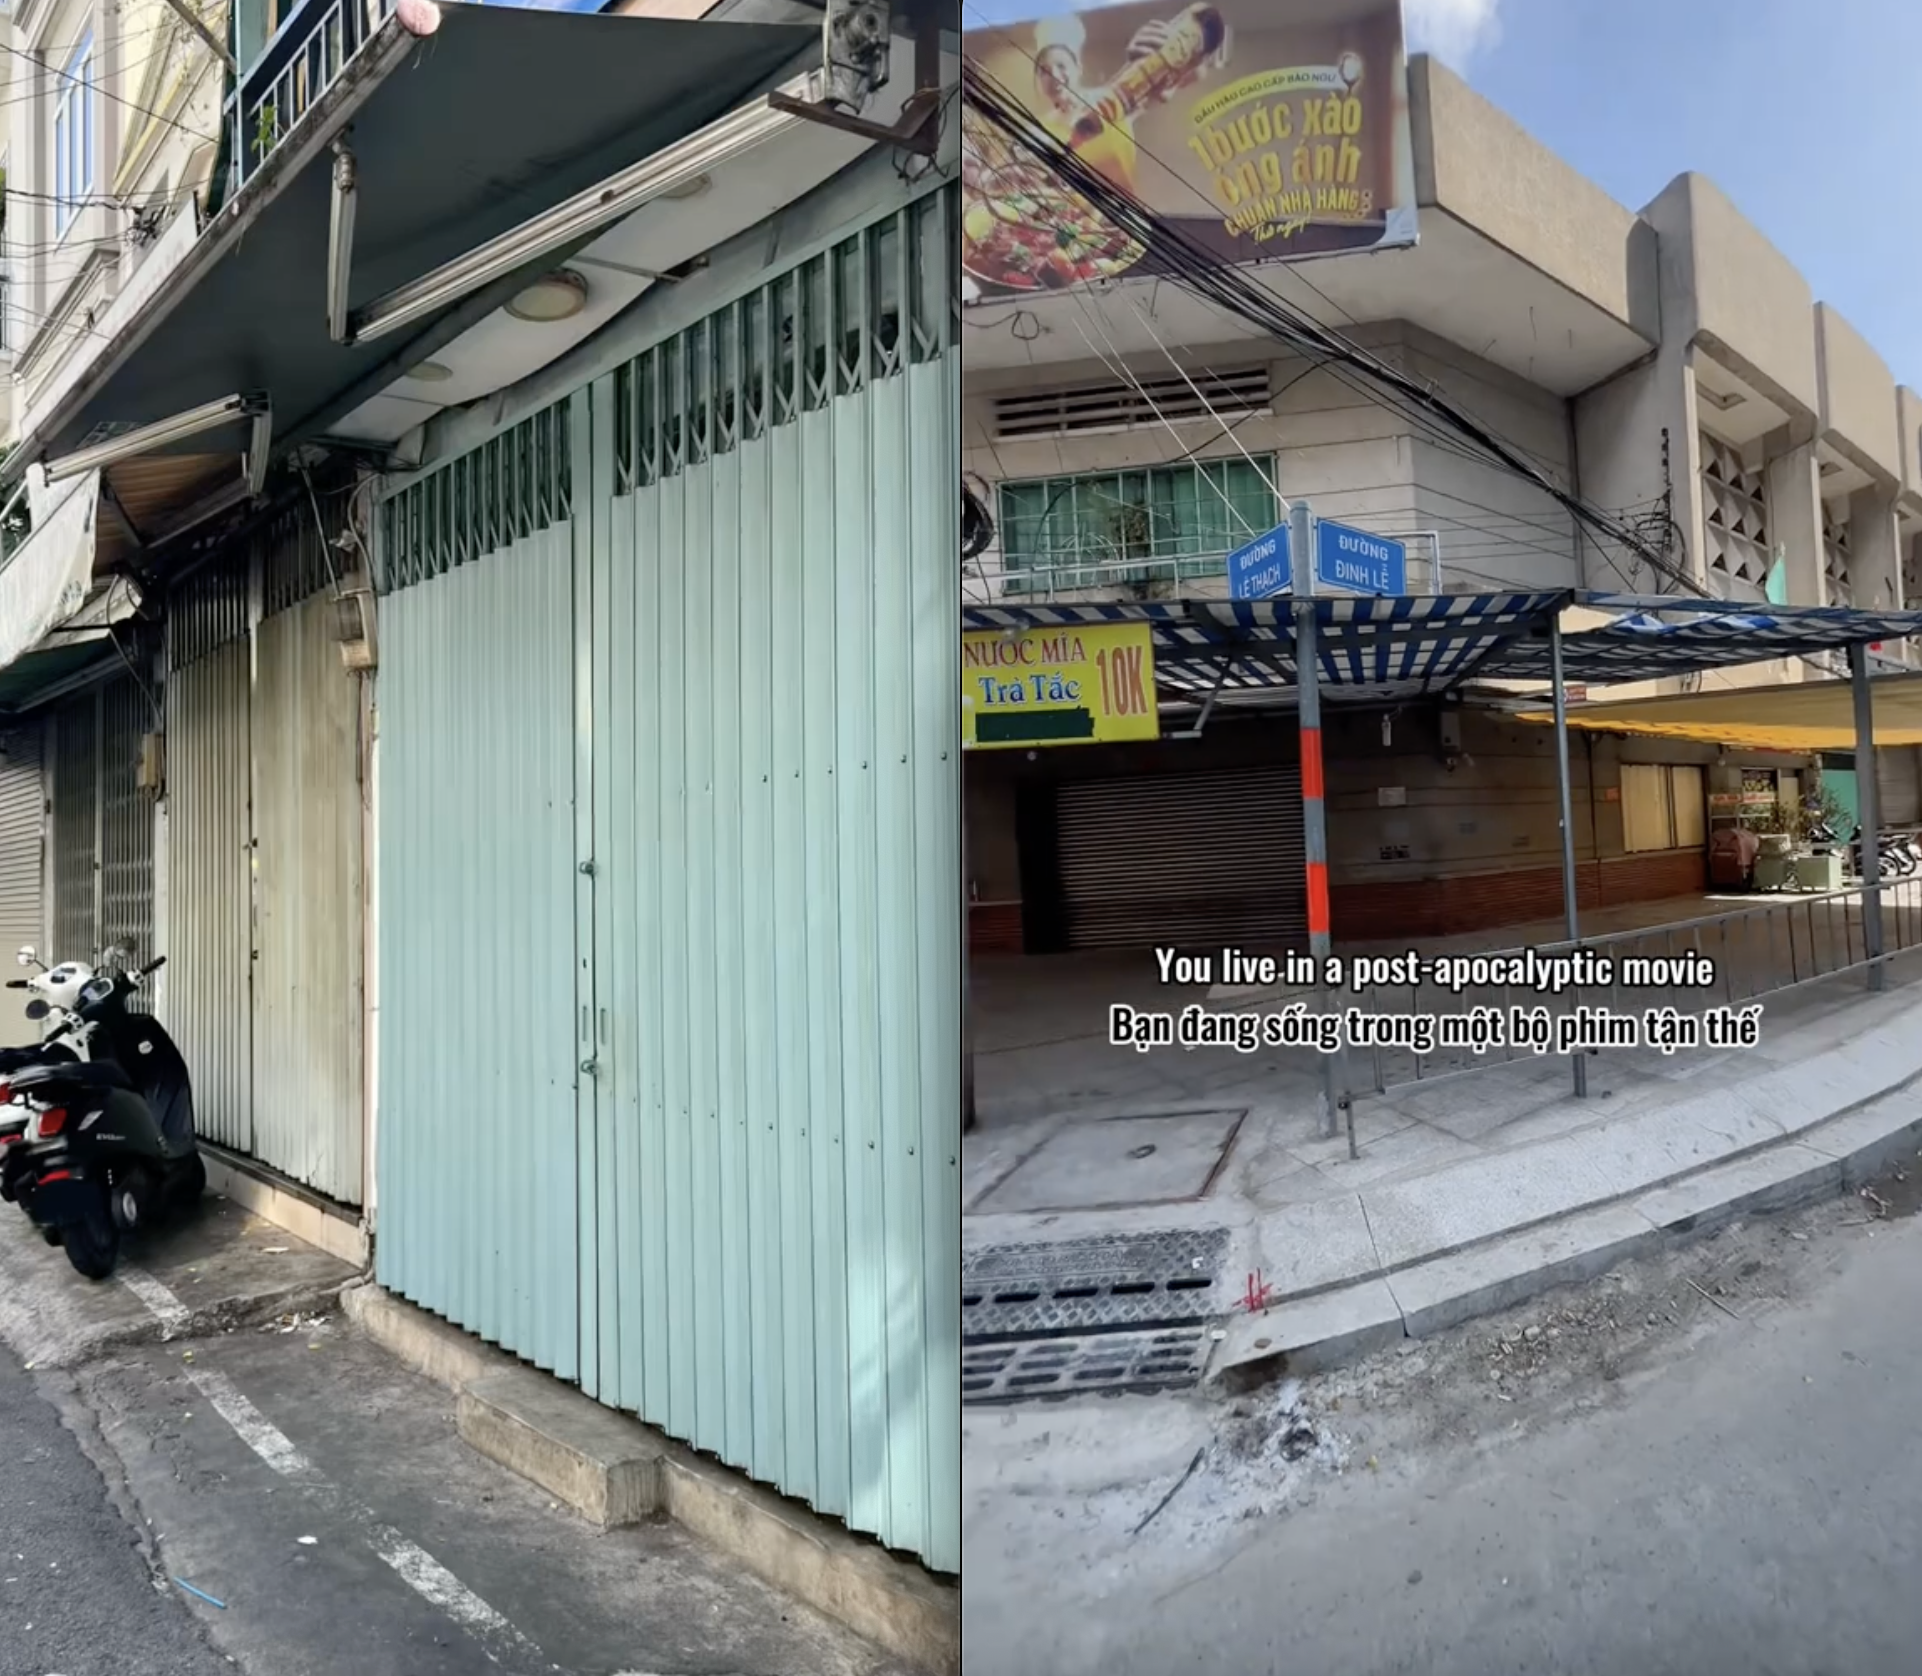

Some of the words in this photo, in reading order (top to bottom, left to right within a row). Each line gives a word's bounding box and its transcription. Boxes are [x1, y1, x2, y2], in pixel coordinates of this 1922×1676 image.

[1206, 102, 1293, 164] bước
[1303, 91, 1363, 136] xào
[1292, 137, 1362, 184] ánh
[1280, 186, 1313, 215] NHÀ
[1317, 185, 1360, 211] HÀNG
[1338, 534, 1389, 562] ĐƯỜNG
[1251, 563, 1282, 593] THẠCH
[1335, 559, 1370, 585] ĐINH
[1042, 632, 1088, 664] MÍA
[979, 676, 1026, 704] Trà
[1030, 671, 1081, 701] Tắc
[1097, 645, 1148, 715] 10K
